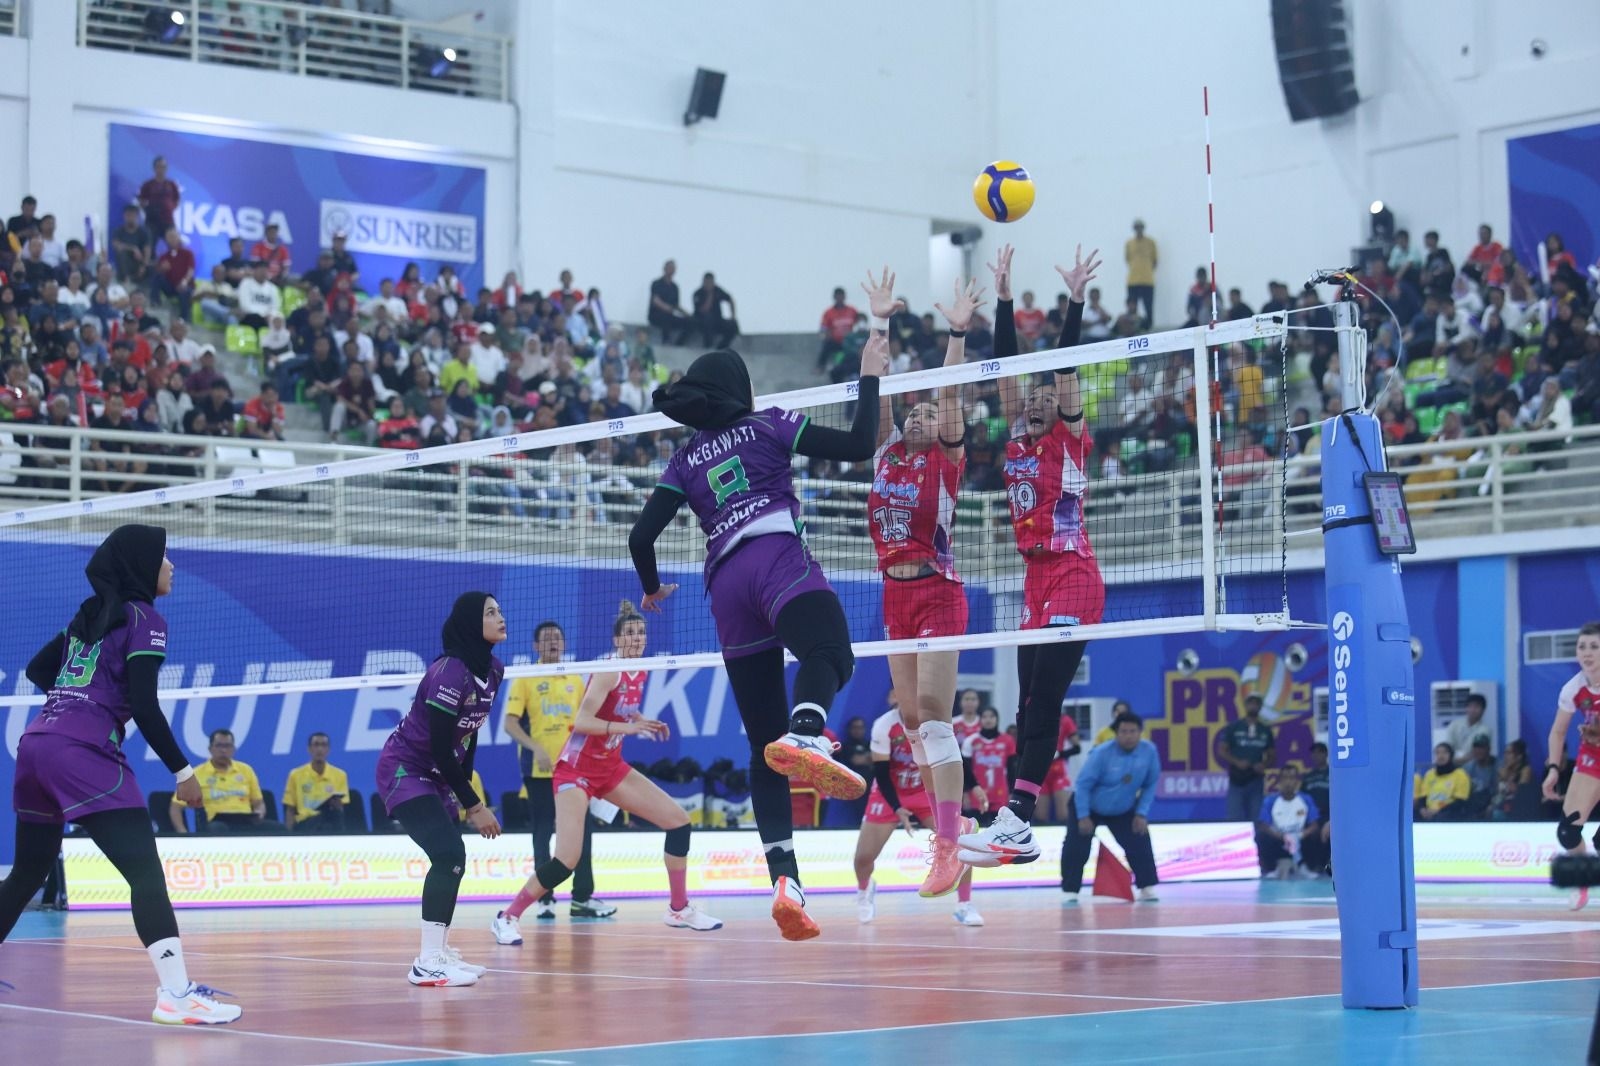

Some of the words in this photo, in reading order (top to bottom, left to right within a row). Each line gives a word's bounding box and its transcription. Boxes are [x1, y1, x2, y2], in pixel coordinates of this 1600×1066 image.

[356, 219, 473, 252] SUNRISE
[1128, 338, 1149, 350] FIVB
[980, 361, 1001, 373] FIVB
[846, 384, 860, 394] FIV
[687, 426, 756, 468] MEGAWATI
[707, 455, 750, 508] 8
[709, 498, 770, 541] Enduro
[1008, 481, 1036, 521] 19
[1325, 504, 1346, 517] FIVB
[873, 506, 911, 543] 15
[1334, 645, 1354, 760] Senoh
